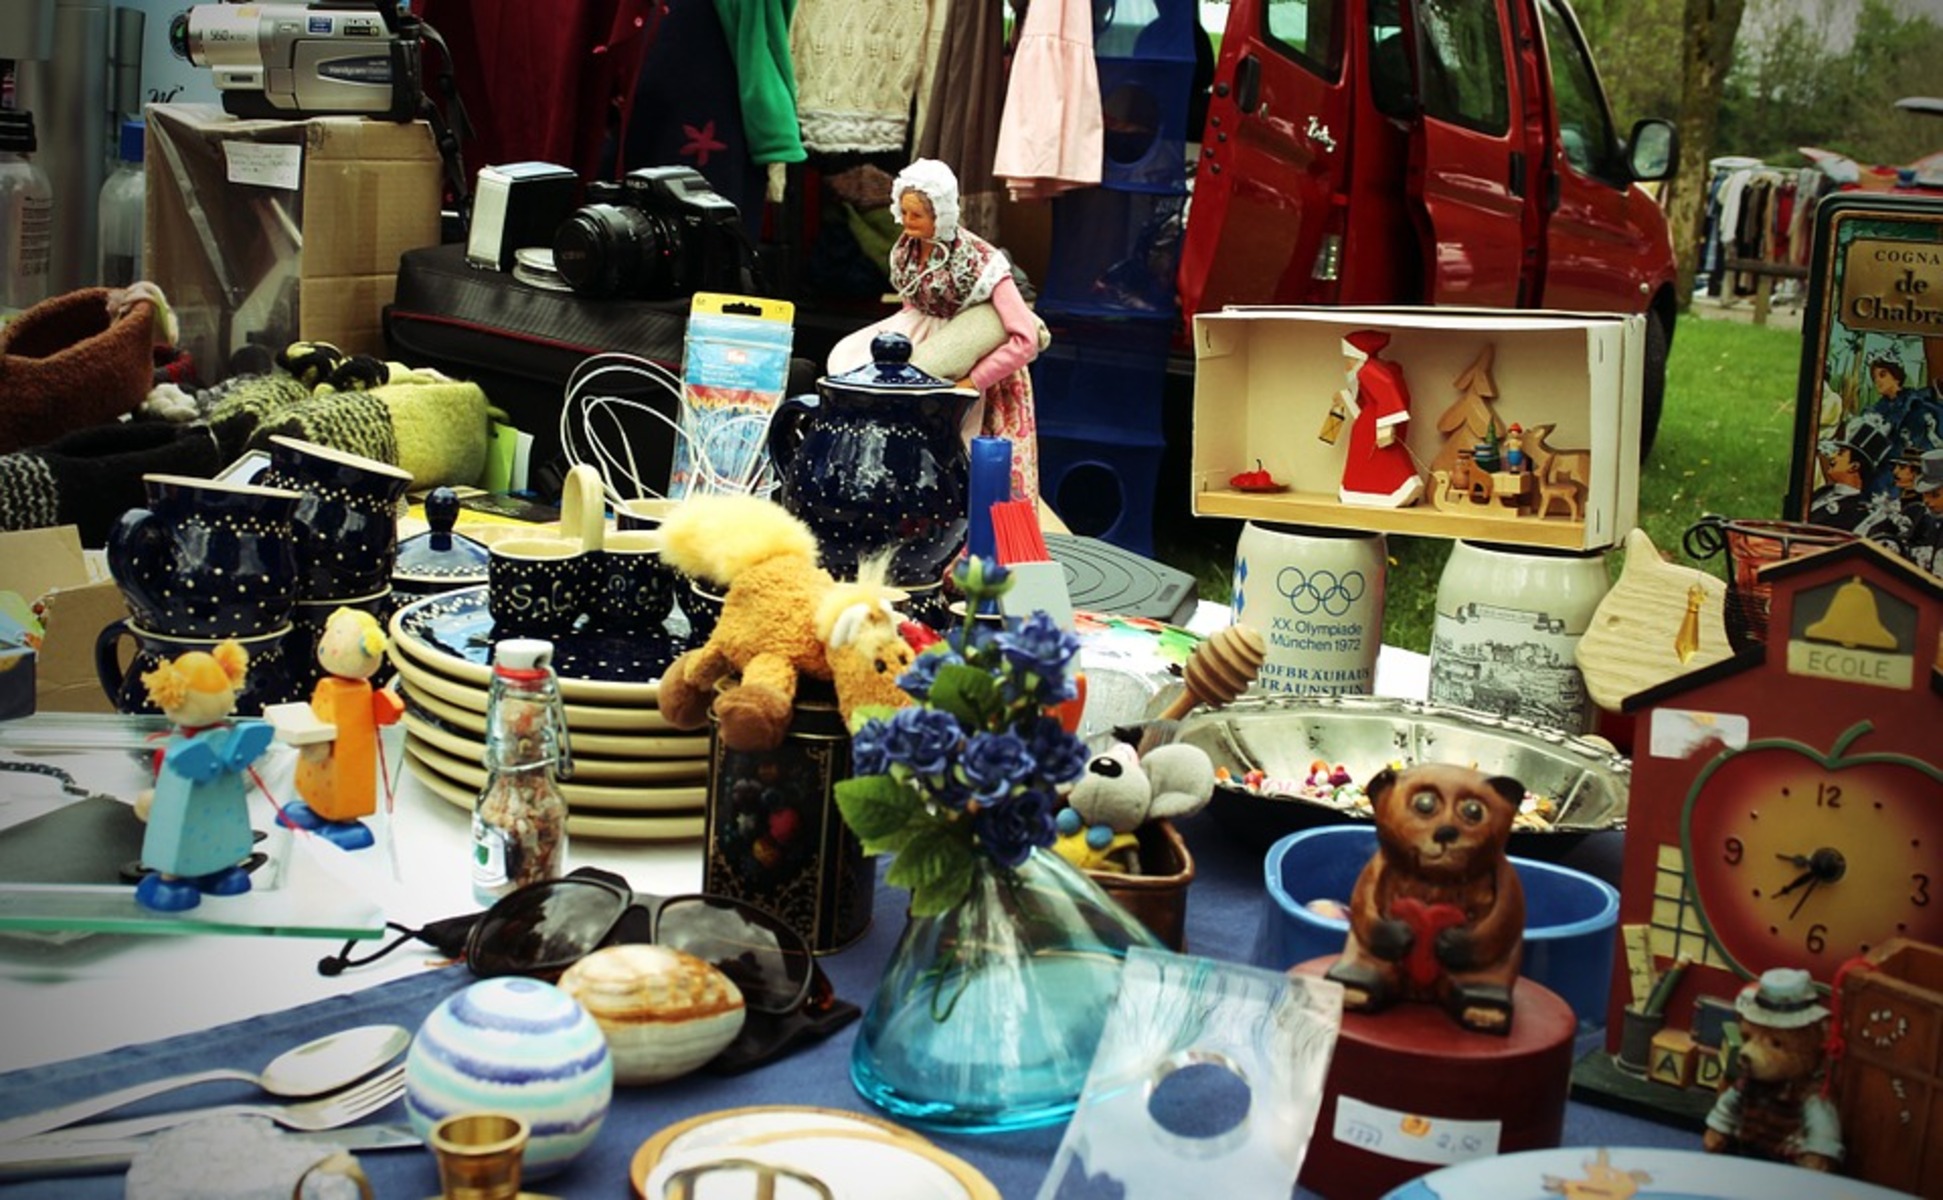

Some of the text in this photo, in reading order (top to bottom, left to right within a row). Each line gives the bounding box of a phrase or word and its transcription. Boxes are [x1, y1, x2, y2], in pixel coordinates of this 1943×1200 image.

[1874, 250, 1940, 265] COGNA
[1895, 269, 1928, 294] de
[1852, 296, 1943, 323] Chabra
[1272, 617, 1363, 637] XX. Olympiade
[1270, 633, 1362, 652] München 1972
[1808, 651, 1891, 681] ECOLE
[1260, 677, 1365, 696] TRAUNSTEIN
[1816, 782, 1843, 809] 12
[1723, 837, 1744, 866] 9
[1910, 873, 1930, 907] 3
[1806, 924, 1828, 954] 6
[1656, 1053, 1680, 1080] A
[1702, 1056, 1723, 1081] D
